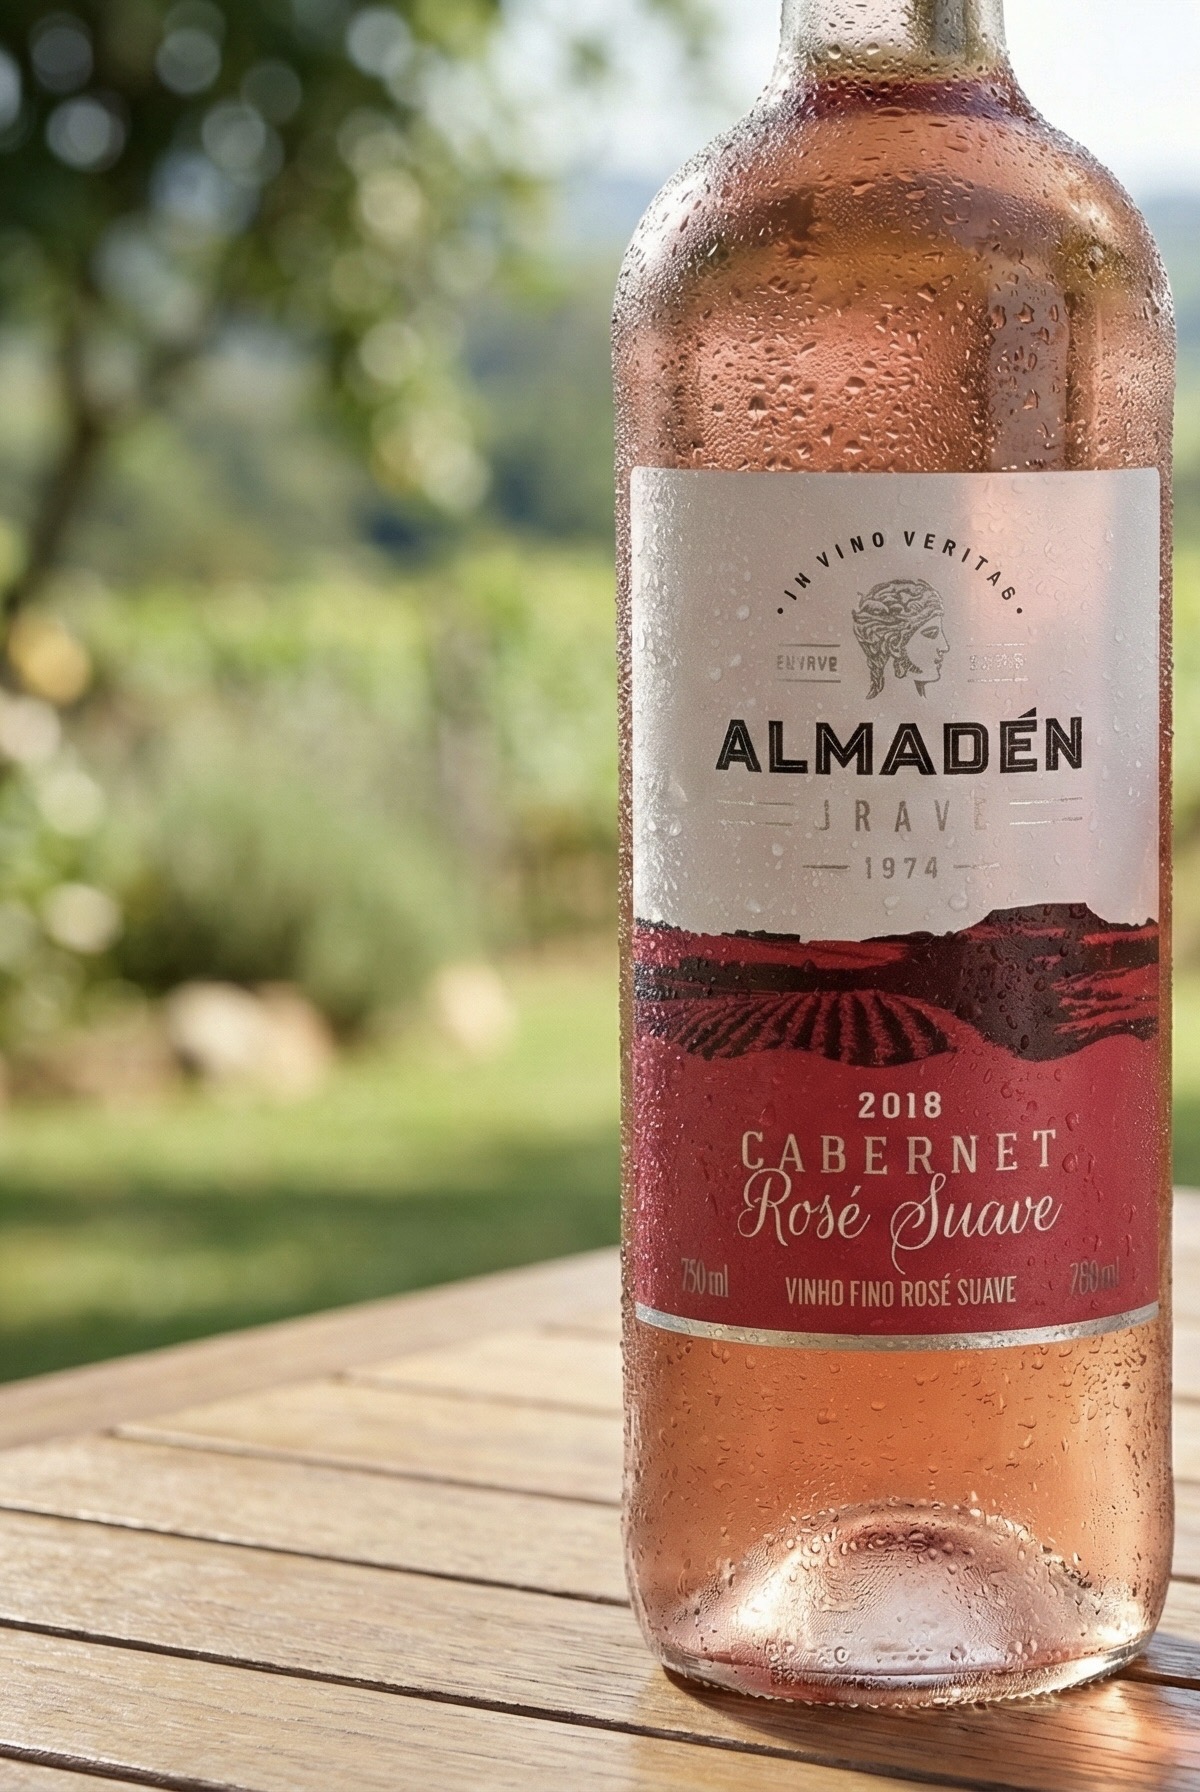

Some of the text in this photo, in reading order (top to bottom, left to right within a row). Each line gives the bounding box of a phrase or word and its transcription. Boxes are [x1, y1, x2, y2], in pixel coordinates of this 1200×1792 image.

[784, 573, 811, 600] IN
[816, 531, 885, 568] VINO
[716, 707, 1083, 776] ALMADÉN
[865, 856, 938, 879] 1974
[858, 1091, 942, 1119] 2018
[741, 1129, 1056, 1175] CABERNET
[737, 1168, 1062, 1275] Rosé Suave
[785, 1274, 1017, 1308] VINHO FINO ROSÉ SUAVE
